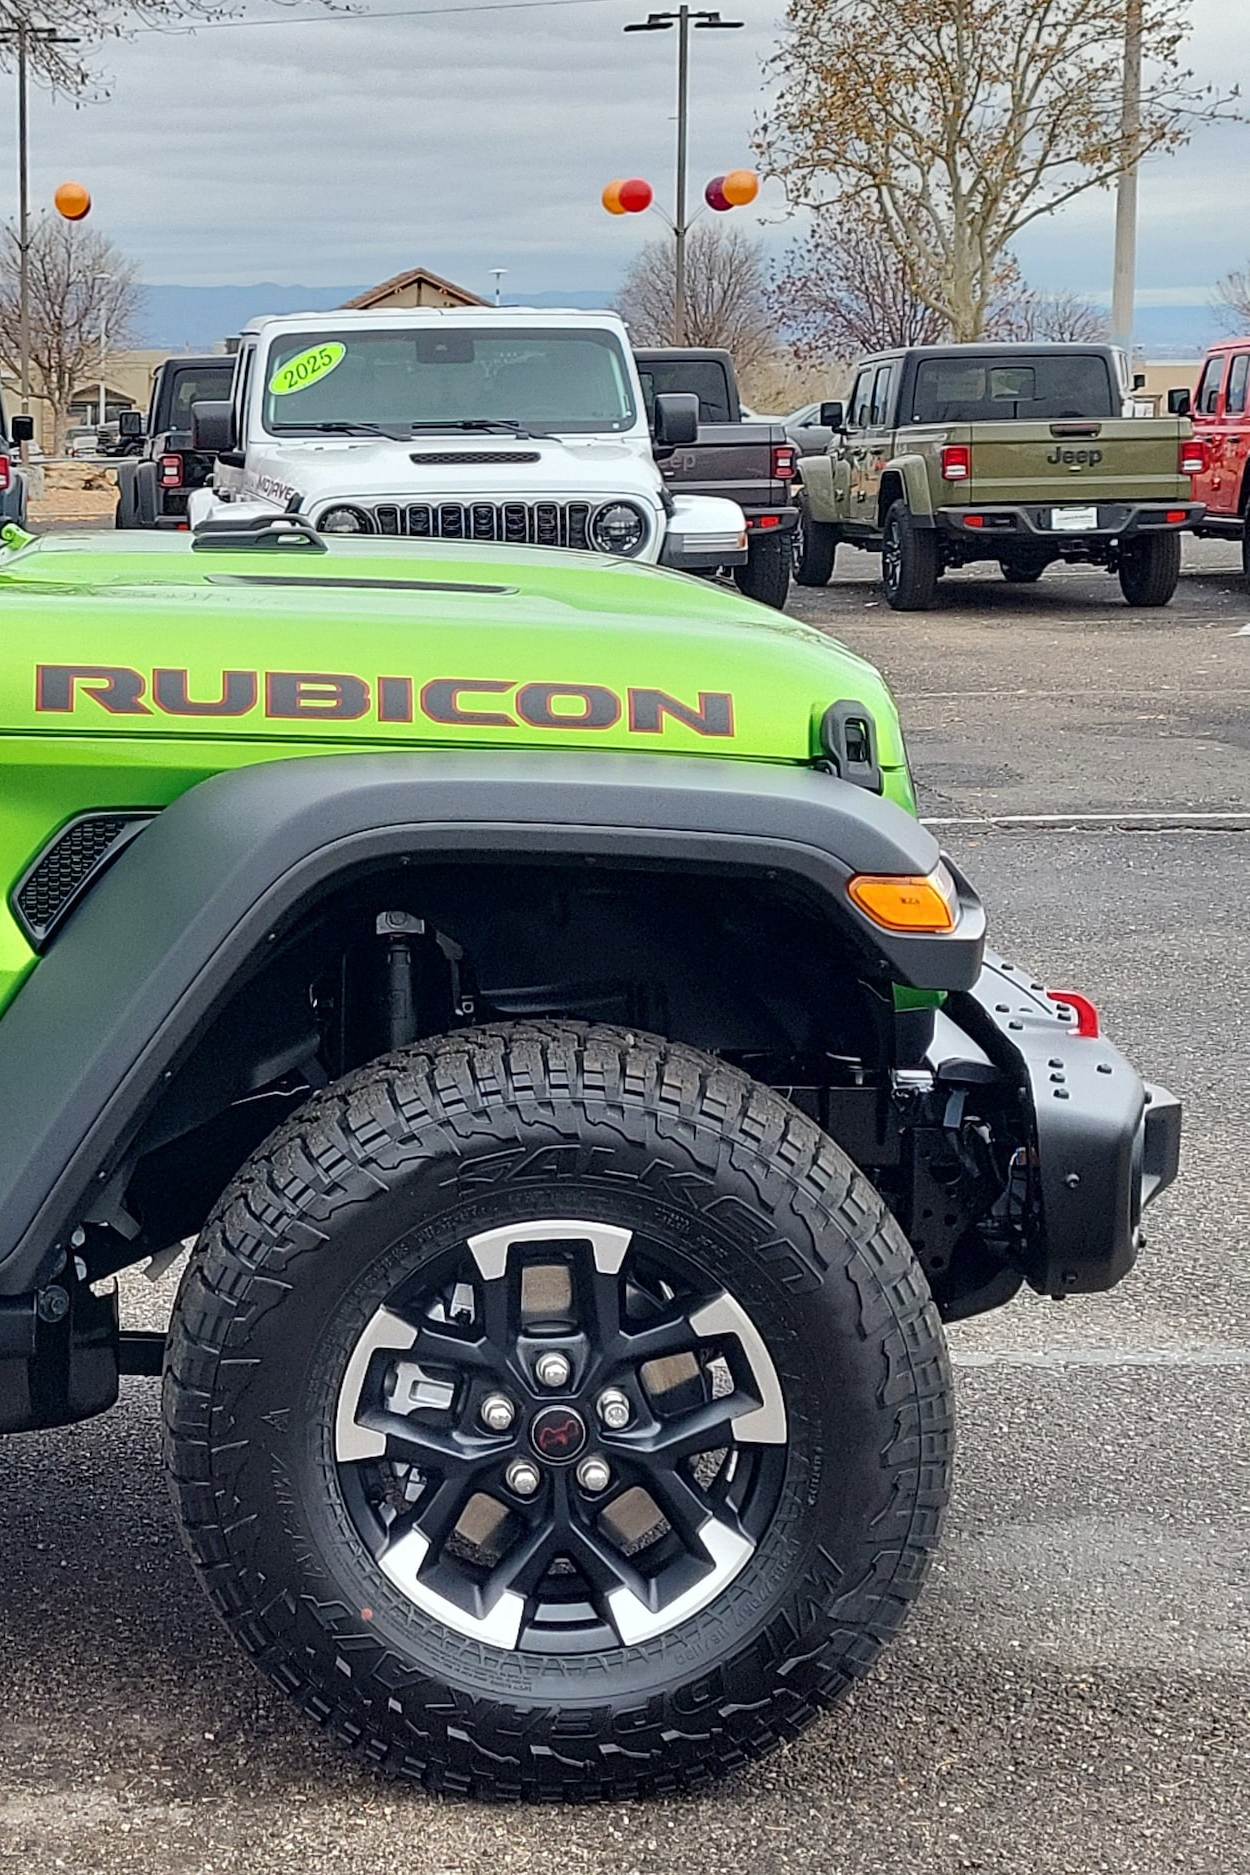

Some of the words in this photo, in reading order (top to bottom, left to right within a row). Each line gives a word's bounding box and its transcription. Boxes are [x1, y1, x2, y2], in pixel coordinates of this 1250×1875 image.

[283, 348, 332, 389] 2025
[1047, 446, 1103, 467] Jeep
[35, 664, 735, 737] RUBICON
